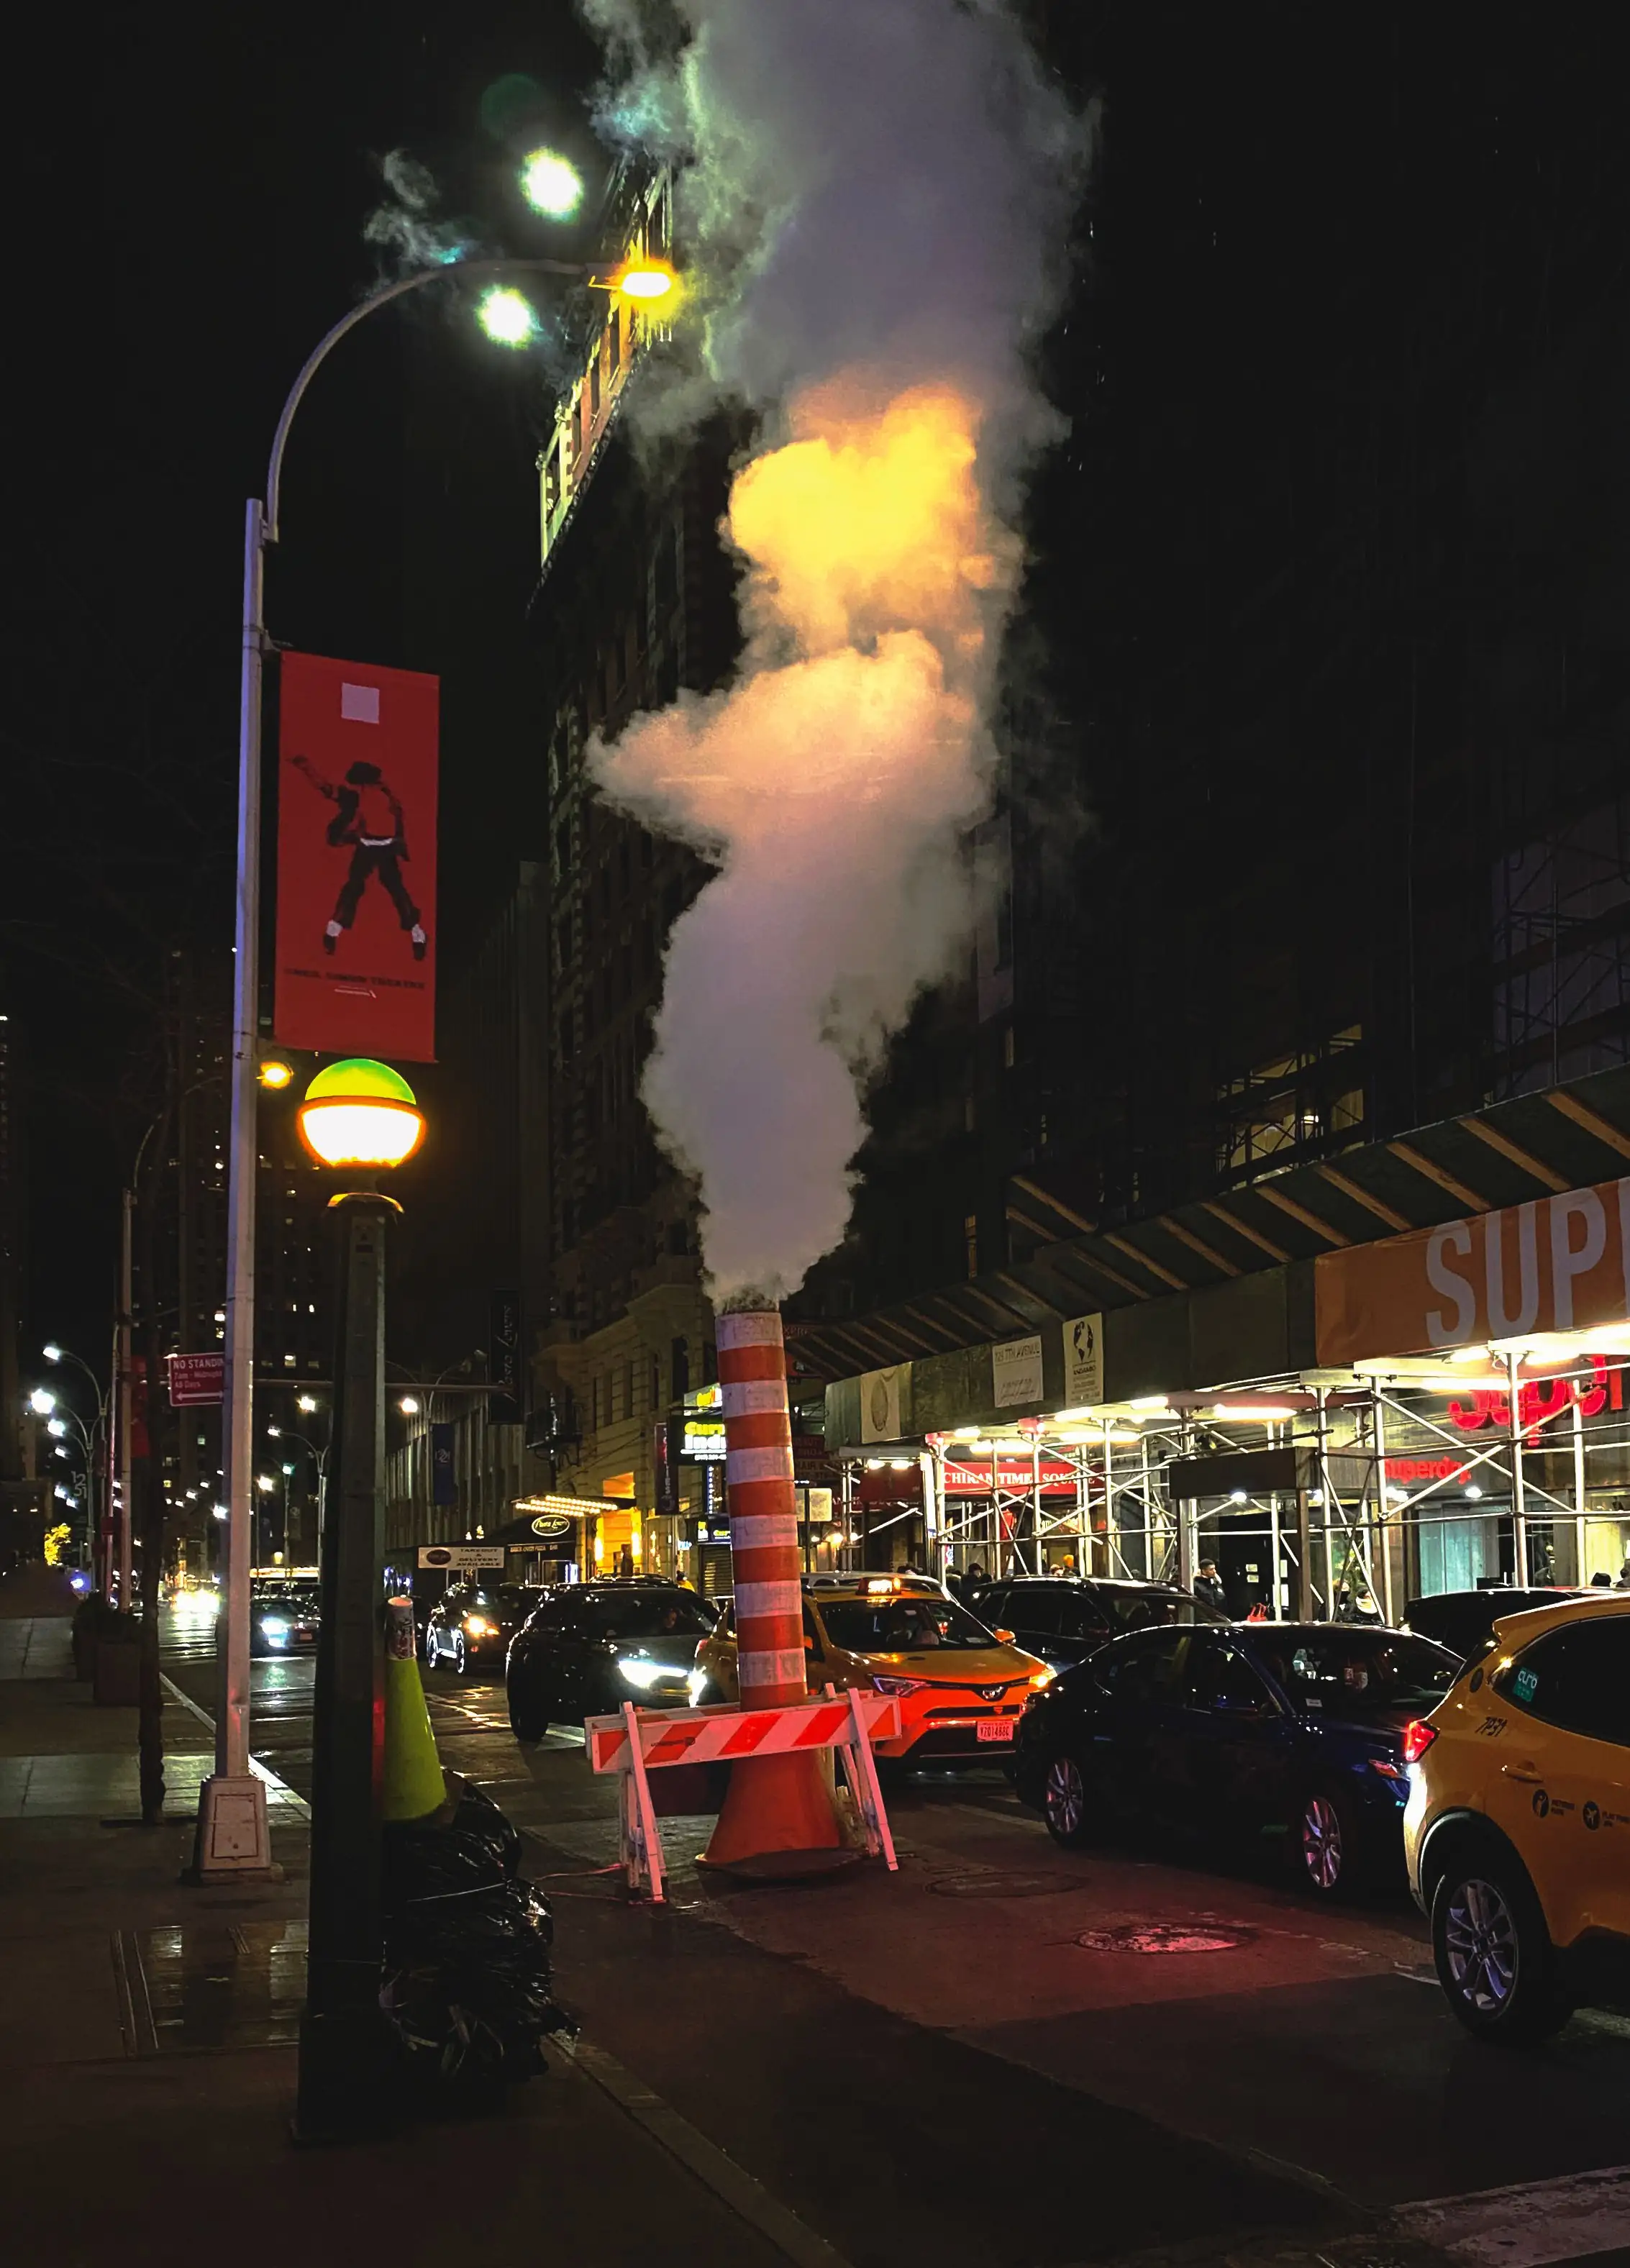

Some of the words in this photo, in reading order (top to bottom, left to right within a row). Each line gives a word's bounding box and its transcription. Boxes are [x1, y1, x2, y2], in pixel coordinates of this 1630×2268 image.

[1425, 1176, 1630, 1348] SUP
[173, 1360, 186, 1370] NO
[188, 1357, 224, 1369] STANDIN
[685, 1421, 725, 1435] Curr
[685, 1434, 726, 1449] Indi
[944, 1472, 993, 1483] CHIRAN
[998, 1472, 1034, 1485] TIME
